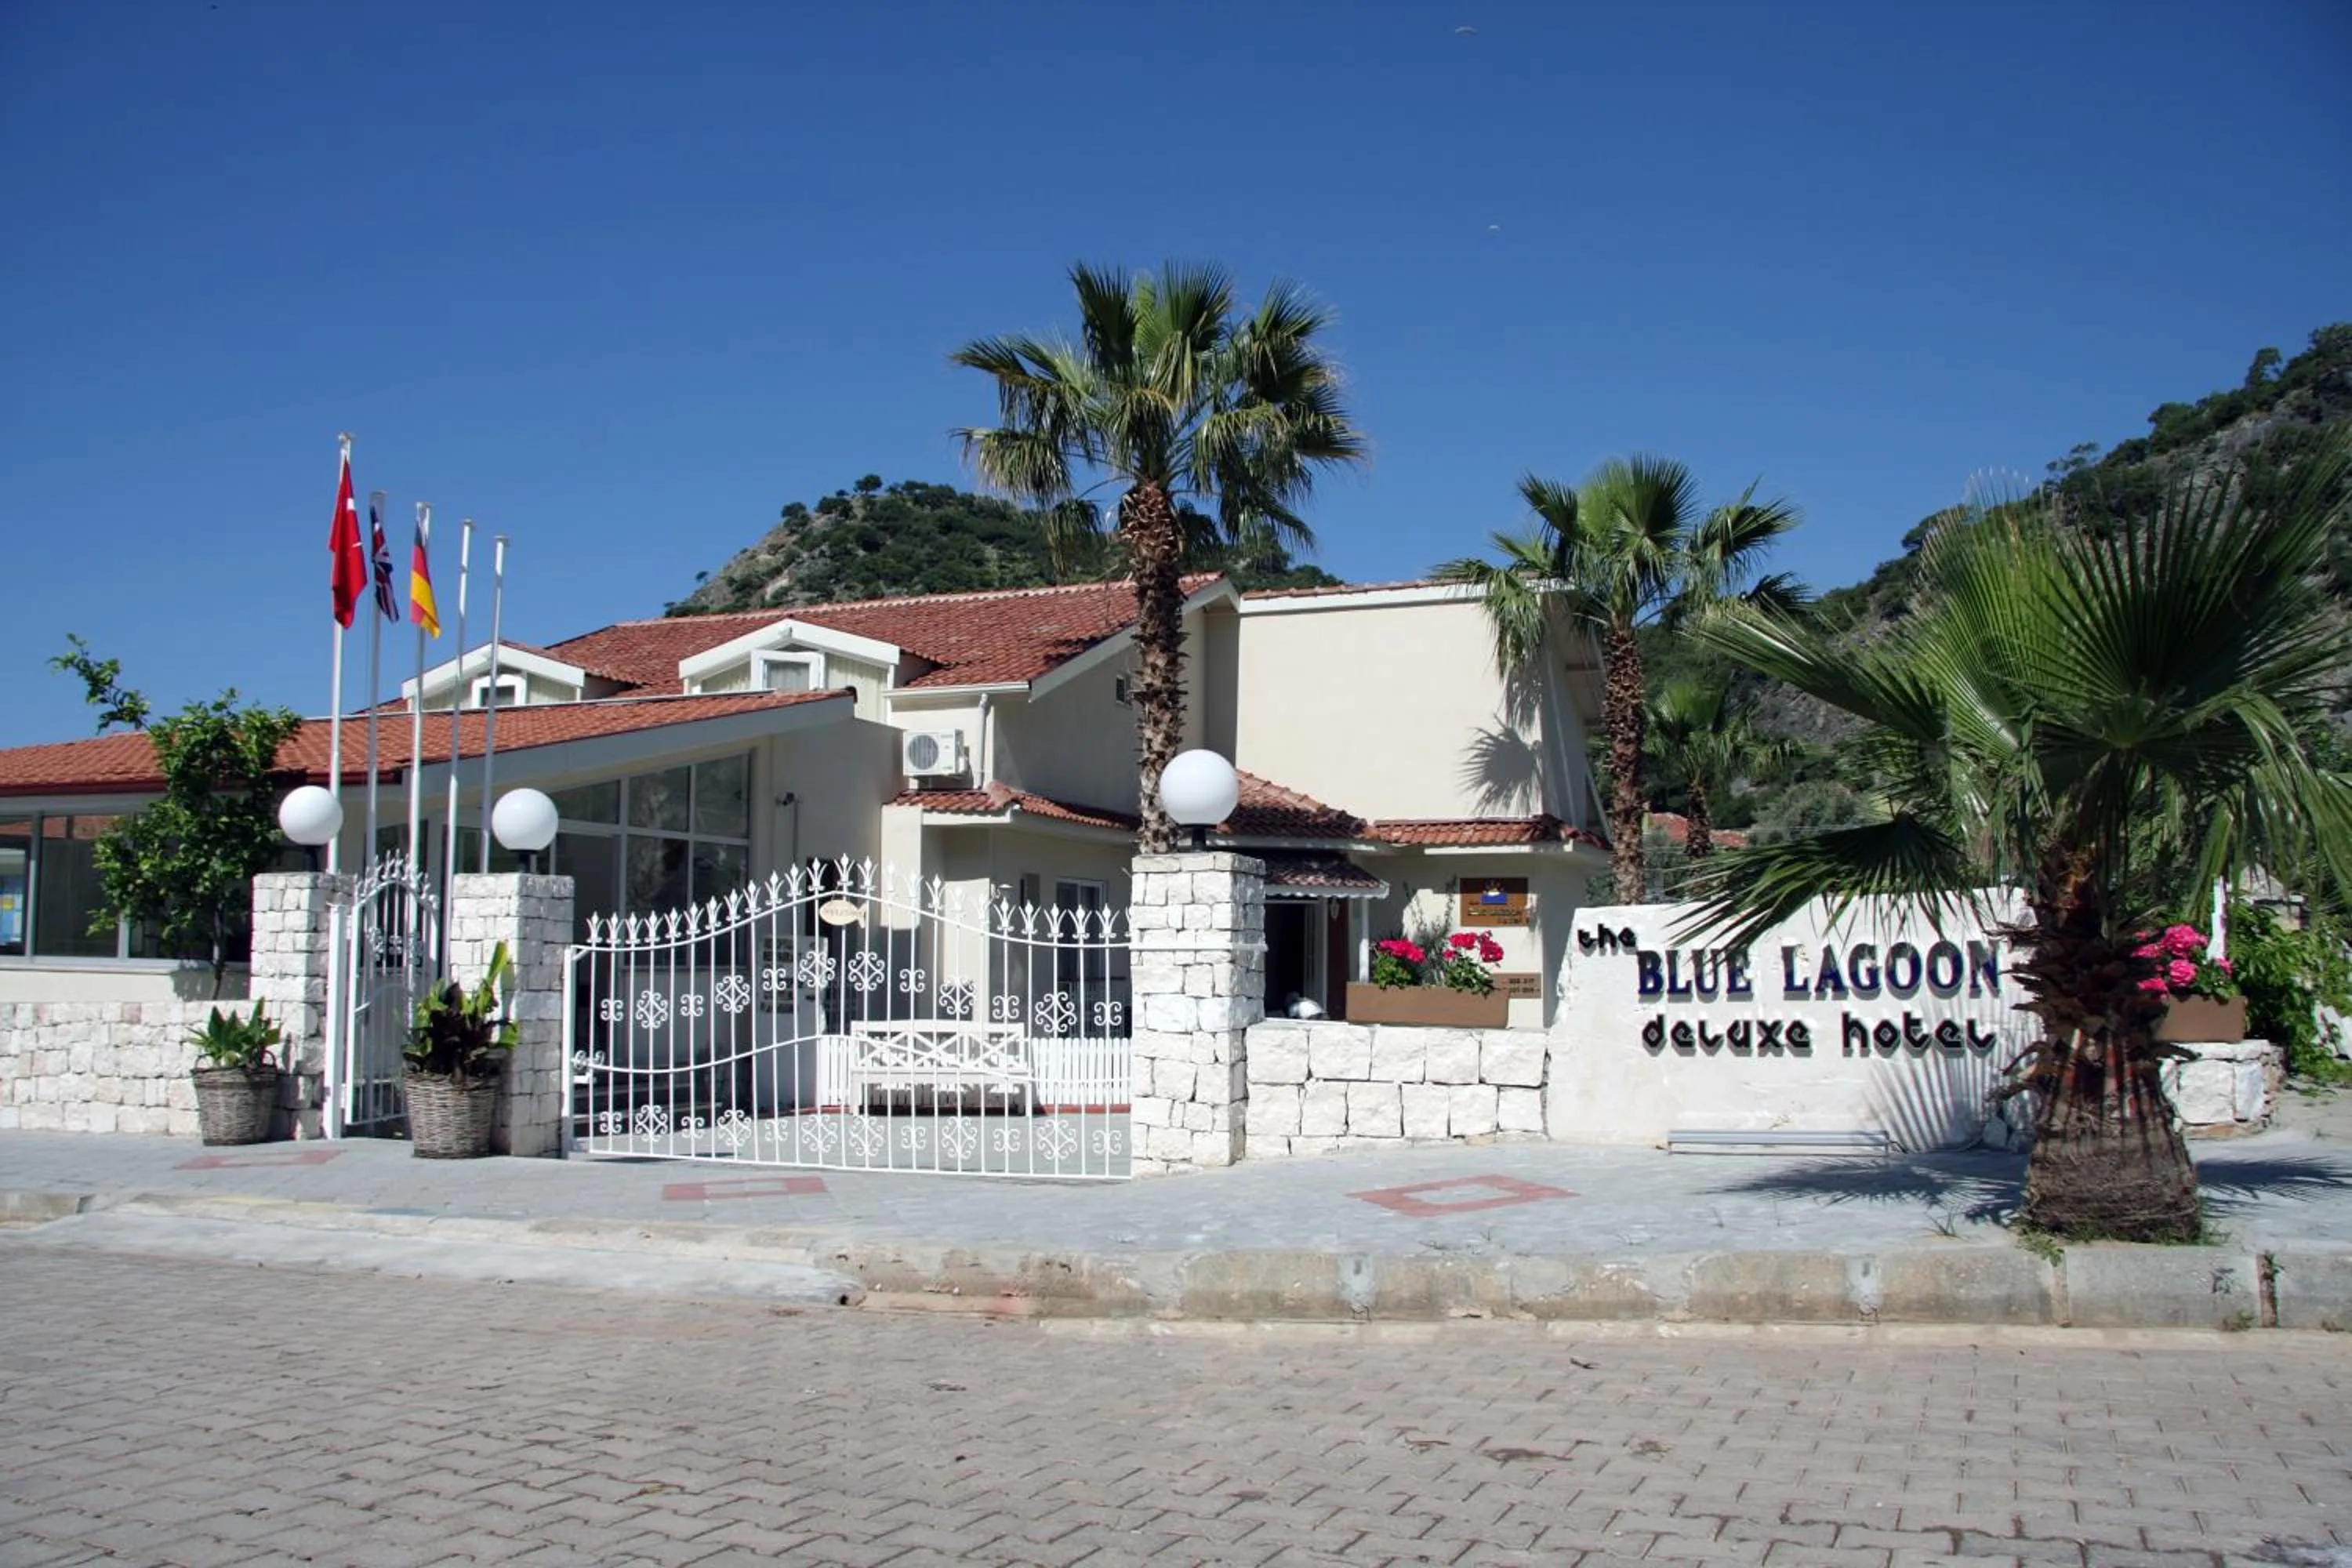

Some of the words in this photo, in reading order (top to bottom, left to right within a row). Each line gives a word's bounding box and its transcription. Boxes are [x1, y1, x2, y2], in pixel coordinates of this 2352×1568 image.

[1577, 923, 1637, 949] the
[1636, 943, 1754, 994] BLUE
[1781, 940, 2000, 996] LAGOON
[1641, 1013, 1811, 1049] deluxe
[1841, 1011, 1997, 1049] hotel
